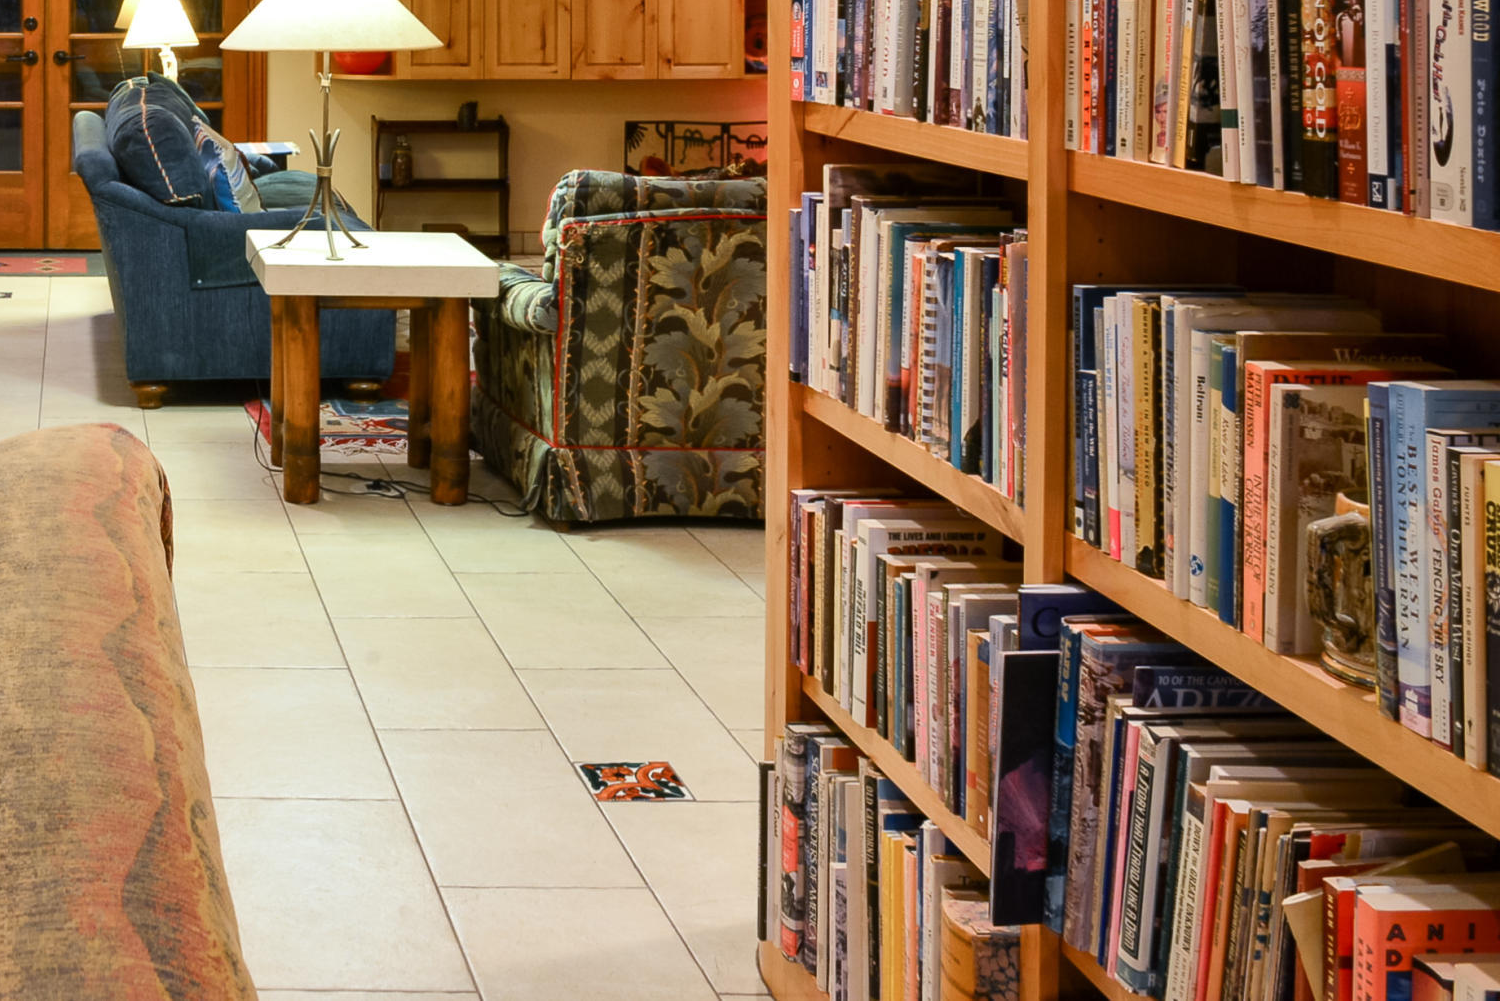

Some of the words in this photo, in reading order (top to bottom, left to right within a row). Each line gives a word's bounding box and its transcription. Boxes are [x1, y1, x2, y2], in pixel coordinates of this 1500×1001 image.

[1091, 13, 1100, 39] BOY
[1288, 12, 1298, 34] FAR
[1313, 18, 1327, 54] OF
[1091, 46, 1099, 64] LA
[1289, 39, 1299, 80] BRIGHT
[1290, 84, 1300, 112] STAR
[1313, 62, 1328, 137] GOLD
[1476, 79, 1487, 114] Pete
[1475, 123, 1487, 183] Dexter
[1245, 371, 1256, 448] MATTHIESSEN
[1407, 445, 1420, 513] BEST
[1429, 439, 1442, 482] James
[1245, 477, 1256, 516] CRAZY
[1253, 474, 1263, 489] IN
[1395, 453, 1408, 511] TONY
[1450, 460, 1461, 516] Lavender
[1253, 491, 1263, 518] THE
[1268, 505, 1277, 540] POCO
[1377, 503, 1385, 540] Modern
[1432, 487, 1444, 536] Galvin
[1464, 486, 1472, 526] FUENTES
[888, 532, 901, 541] THE
[903, 532, 924, 541] LIVES
[925, 532, 941, 541] AND
[942, 532, 975, 541] LEGENDS
[977, 532, 986, 541] OF
[1245, 518, 1256, 568] HORSE
[1252, 521, 1263, 559] SPIRIT
[1450, 529, 1461, 560] One
[1485, 499, 1497, 567] CRUZ
[1253, 562, 1263, 584] OF
[1267, 543, 1276, 596] TIEMPO
[1378, 542, 1387, 588] American
[1432, 548, 1443, 616] FENCING
[855, 578, 863, 628] BUFFALO
[1398, 519, 1411, 650] HILLERMAN
[1408, 549, 1421, 623] WEST
[1465, 586, 1473, 604] THE
[876, 599, 885, 652] Jedediah
[1465, 606, 1473, 626] OLD
[855, 631, 863, 655] BILL
[1433, 621, 1443, 650] THE
[1451, 622, 1462, 663] West
[1465, 629, 1473, 666] GRINGO
[877, 654, 885, 693] Smith
[1158, 675, 1170, 685] 10
[1171, 675, 1184, 685] OF
[1187, 675, 1205, 685] THE
[1433, 654, 1445, 683] SKY
[810, 755, 820, 798] SCENIC
[1140, 765, 1148, 773] A
[865, 785, 875, 805] OLD
[1136, 776, 1149, 813] STORY
[809, 801, 820, 864] WONDERS
[865, 808, 876, 864] CALIFORNIA
[1135, 815, 1146, 842] THAT
[1192, 823, 1202, 854] DOWN
[809, 867, 819, 884] OF
[1131, 842, 1146, 883] STANDS
[1128, 883, 1140, 907] LIKE
[1187, 867, 1198, 902] GREAT
[807, 886, 819, 940] AMERICA
[1127, 908, 1137, 916] A
[1182, 903, 1195, 954] UNKNOWN
[1326, 894, 1334, 929] HIGH
[1124, 917, 1137, 949] DAM
[1327, 934, 1335, 965] TIDE
[1327, 969, 1335, 987] IN
